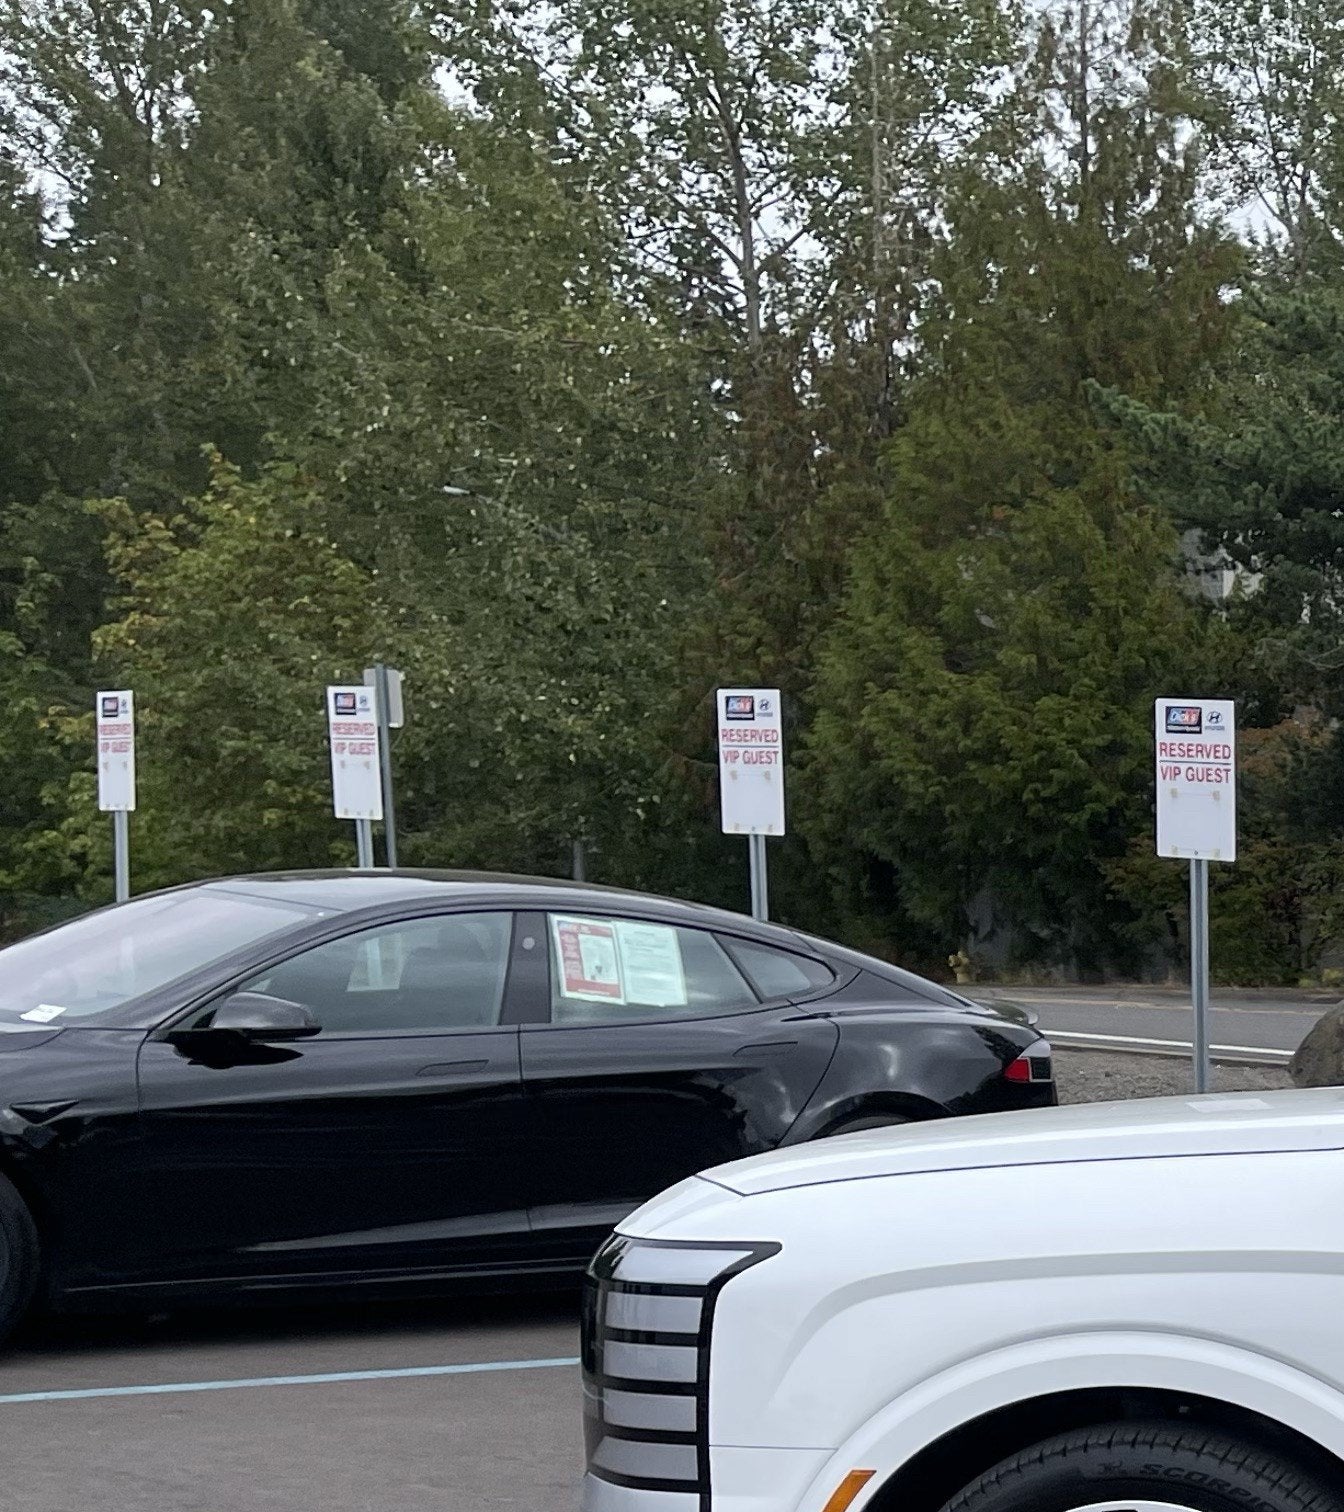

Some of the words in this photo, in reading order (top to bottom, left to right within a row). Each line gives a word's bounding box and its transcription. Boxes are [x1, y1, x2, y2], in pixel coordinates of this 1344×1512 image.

[721, 728, 779, 743] RESERVED
[722, 750, 740, 764] VIP
[742, 750, 779, 765] GUEST
[1159, 741, 1232, 760] RESERVED
[1160, 765, 1181, 781] VIP
[1185, 766, 1232, 784] GUEST
